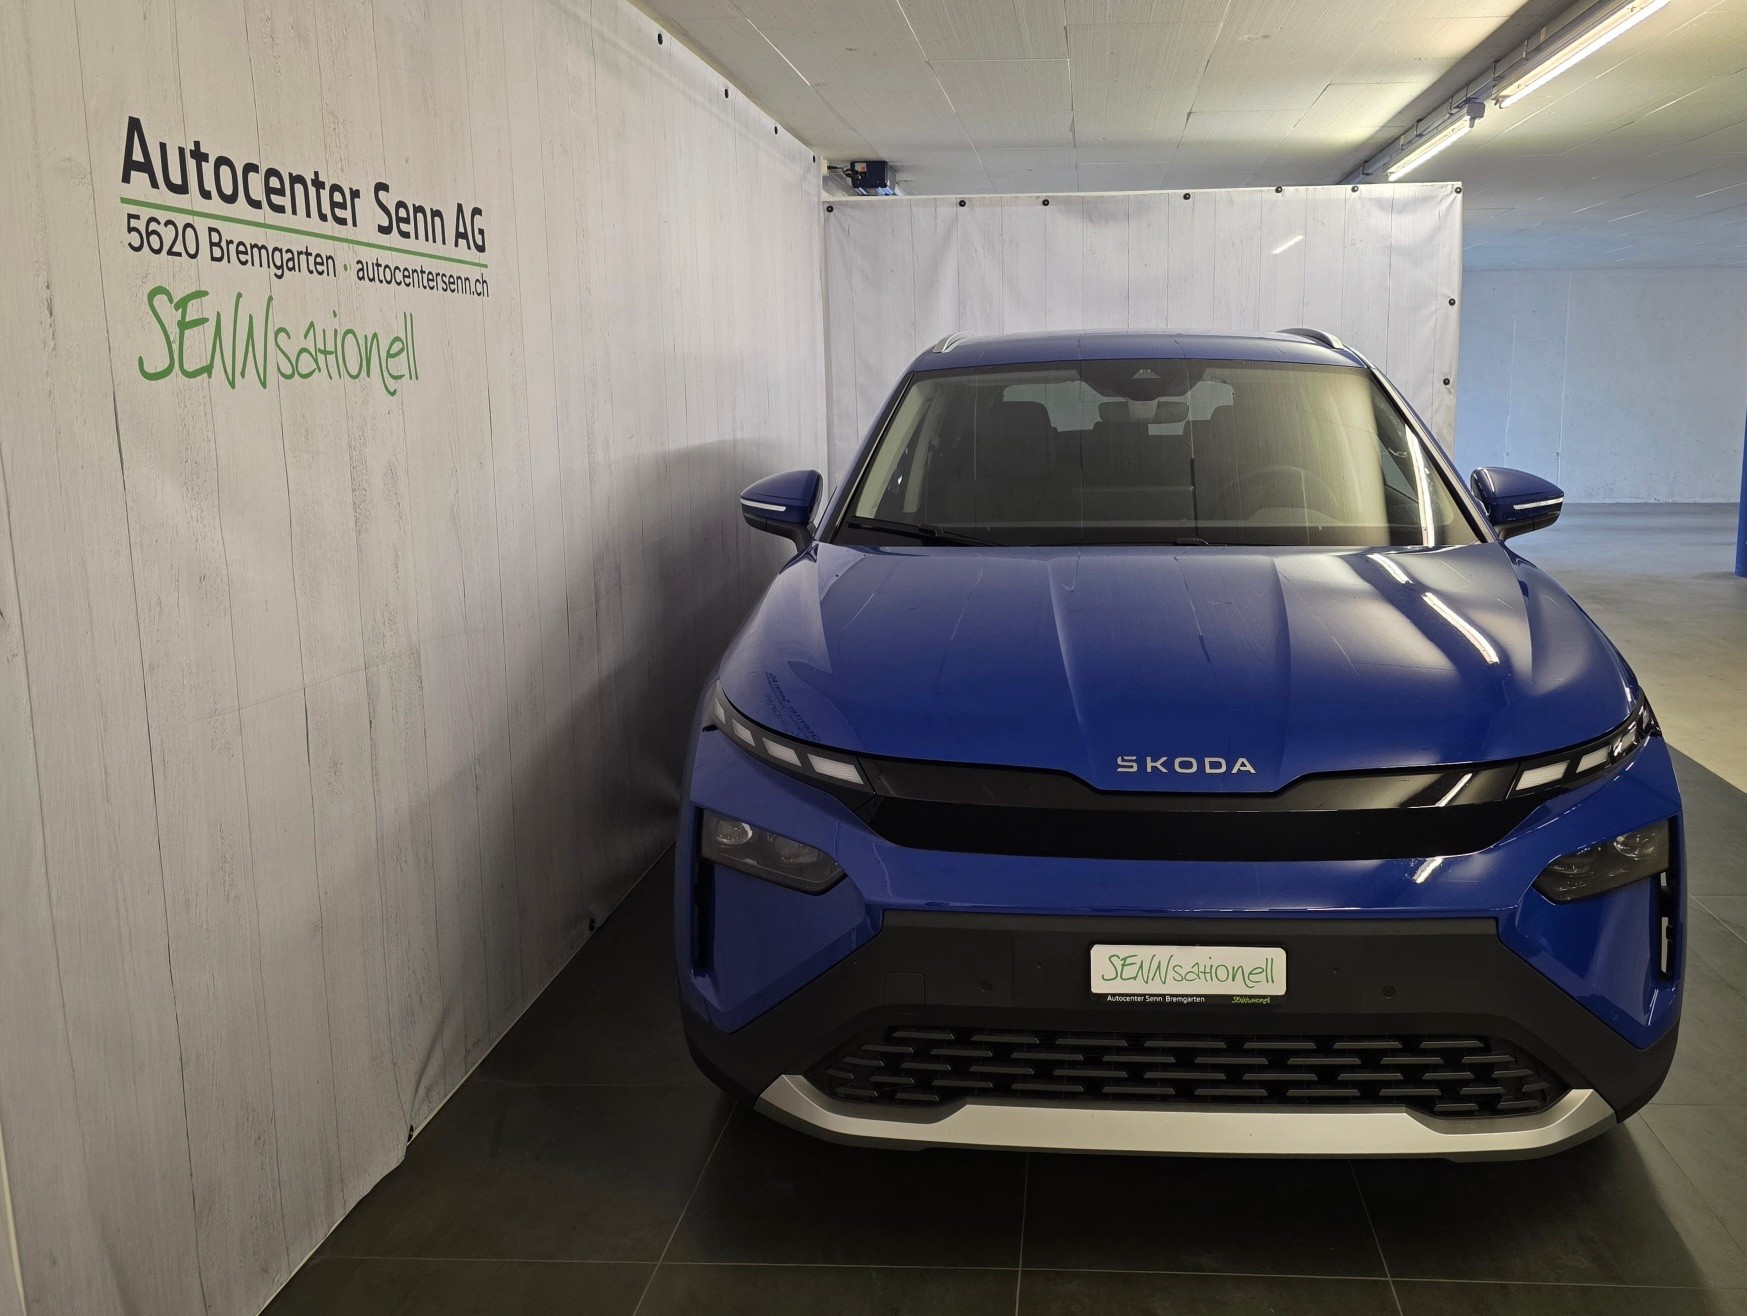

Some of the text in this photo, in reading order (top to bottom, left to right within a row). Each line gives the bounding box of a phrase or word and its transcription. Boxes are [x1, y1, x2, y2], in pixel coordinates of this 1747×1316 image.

[121, 115, 487, 254] Autocenter Senn AG
[126, 213, 490, 298] 5620 Bremgarten autocentersenn.ch
[138, 285, 419, 397] SENNsationell
[1101, 954, 1275, 989] SENNsationell
[1107, 994, 1206, 1004] Autocenter Senn Bremgarten
